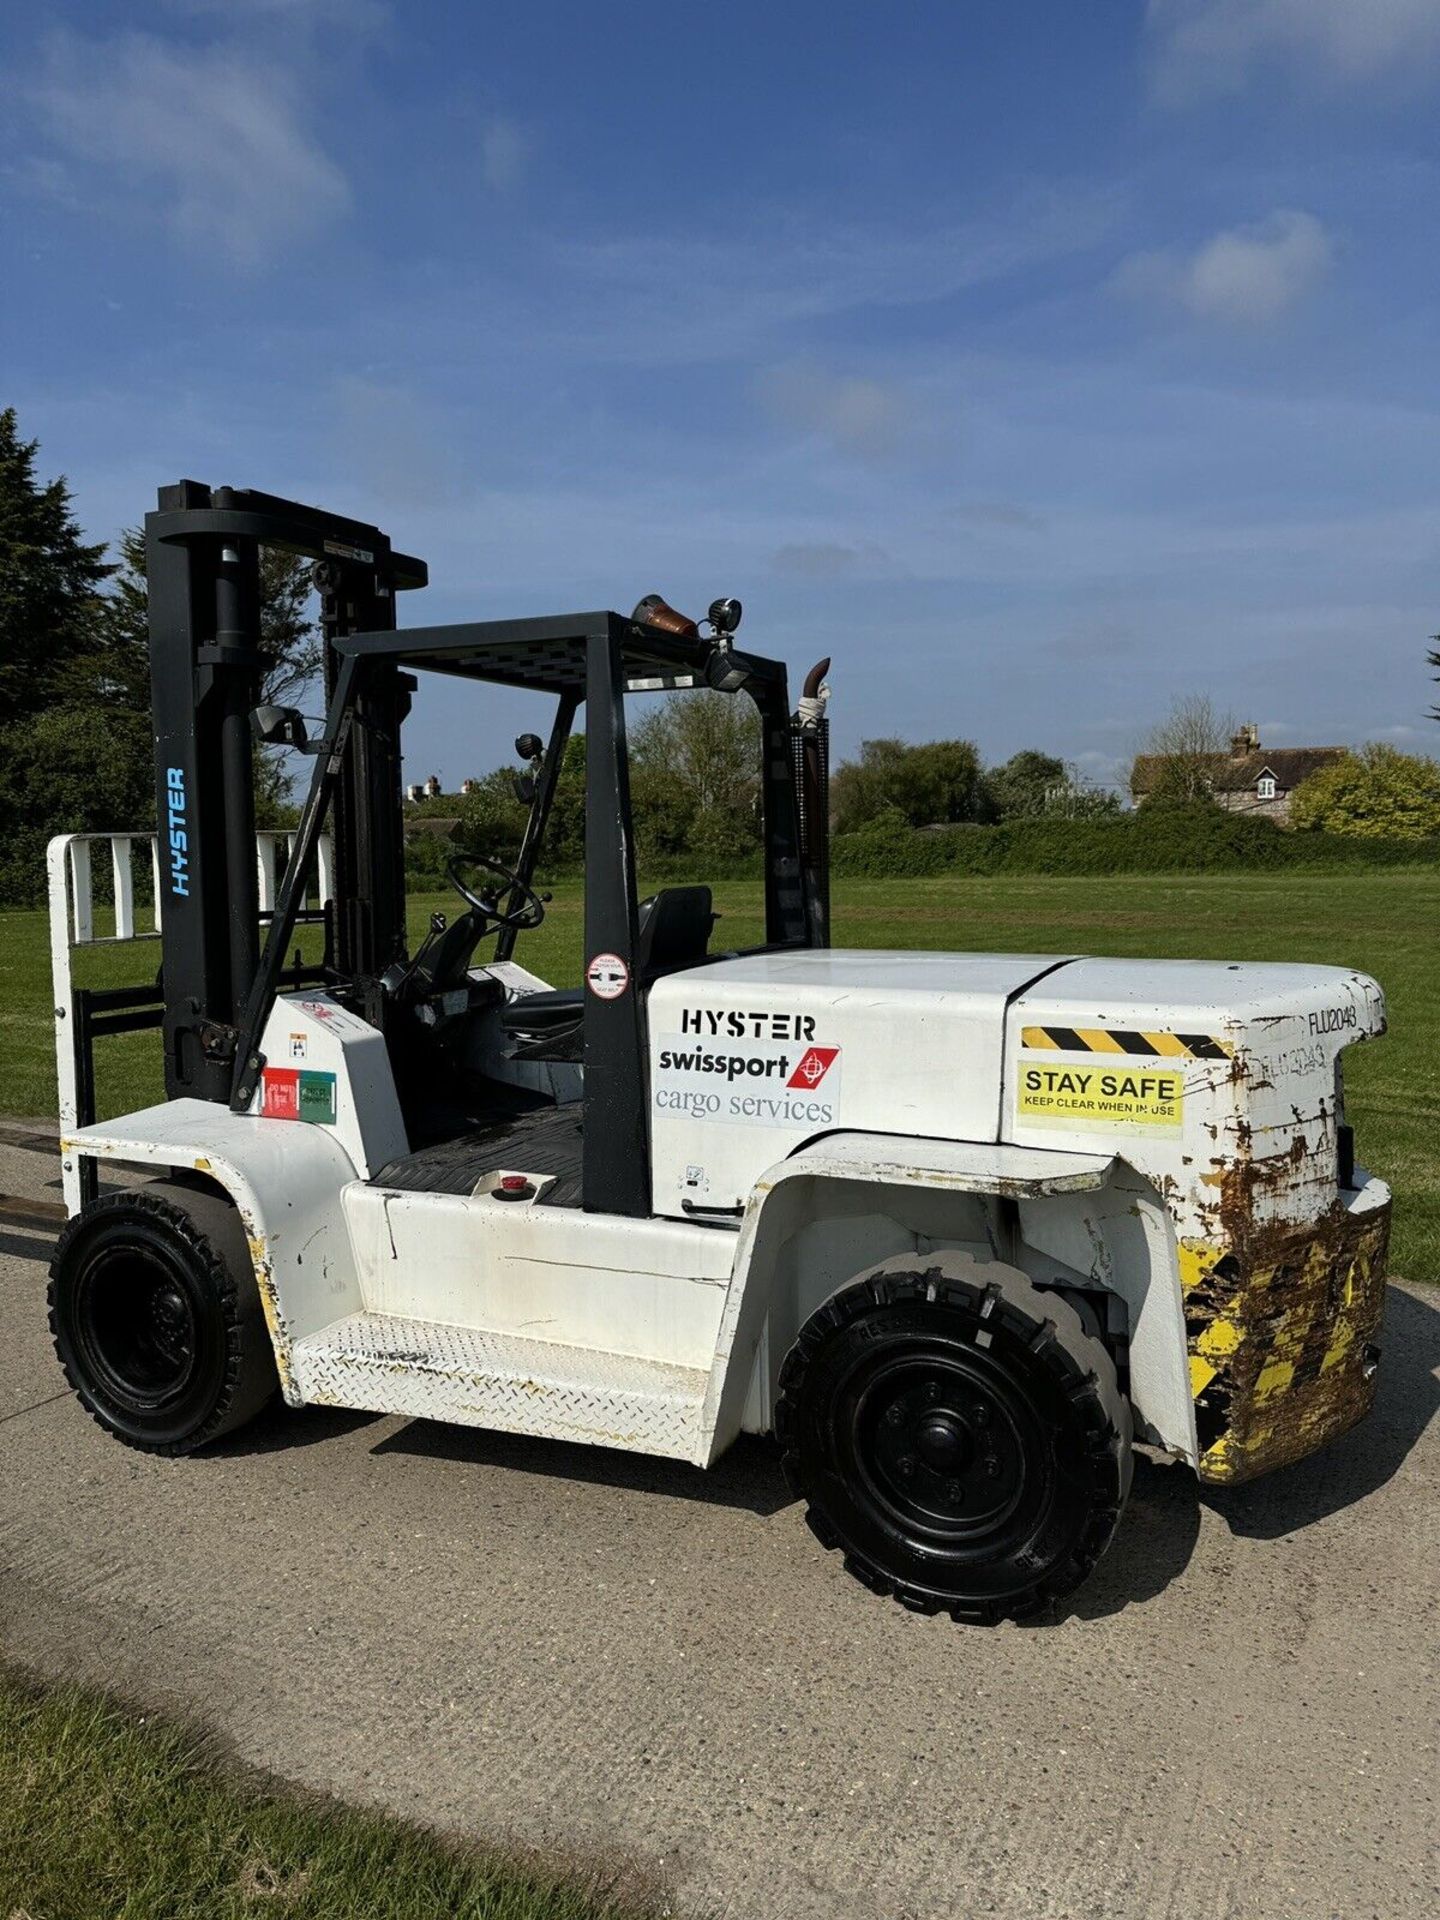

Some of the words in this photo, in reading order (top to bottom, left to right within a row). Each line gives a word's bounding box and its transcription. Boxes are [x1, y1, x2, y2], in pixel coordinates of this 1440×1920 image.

[167, 767, 189, 896] HYSTER
[681, 1008, 816, 1042] HYSTER
[1308, 1005, 1357, 1036] FLU2043
[659, 1045, 789, 1082] swissport
[1025, 1070, 1092, 1094] STAY
[1100, 1075, 1175, 1100] SAFE
[656, 1088, 721, 1118] cargo
[729, 1093, 833, 1123] services
[1024, 1096, 1054, 1106] KEEP
[1056, 1098, 1095, 1110] CLEAR
[1097, 1101, 1132, 1113] WHEN
[1151, 1106, 1175, 1116] USE
